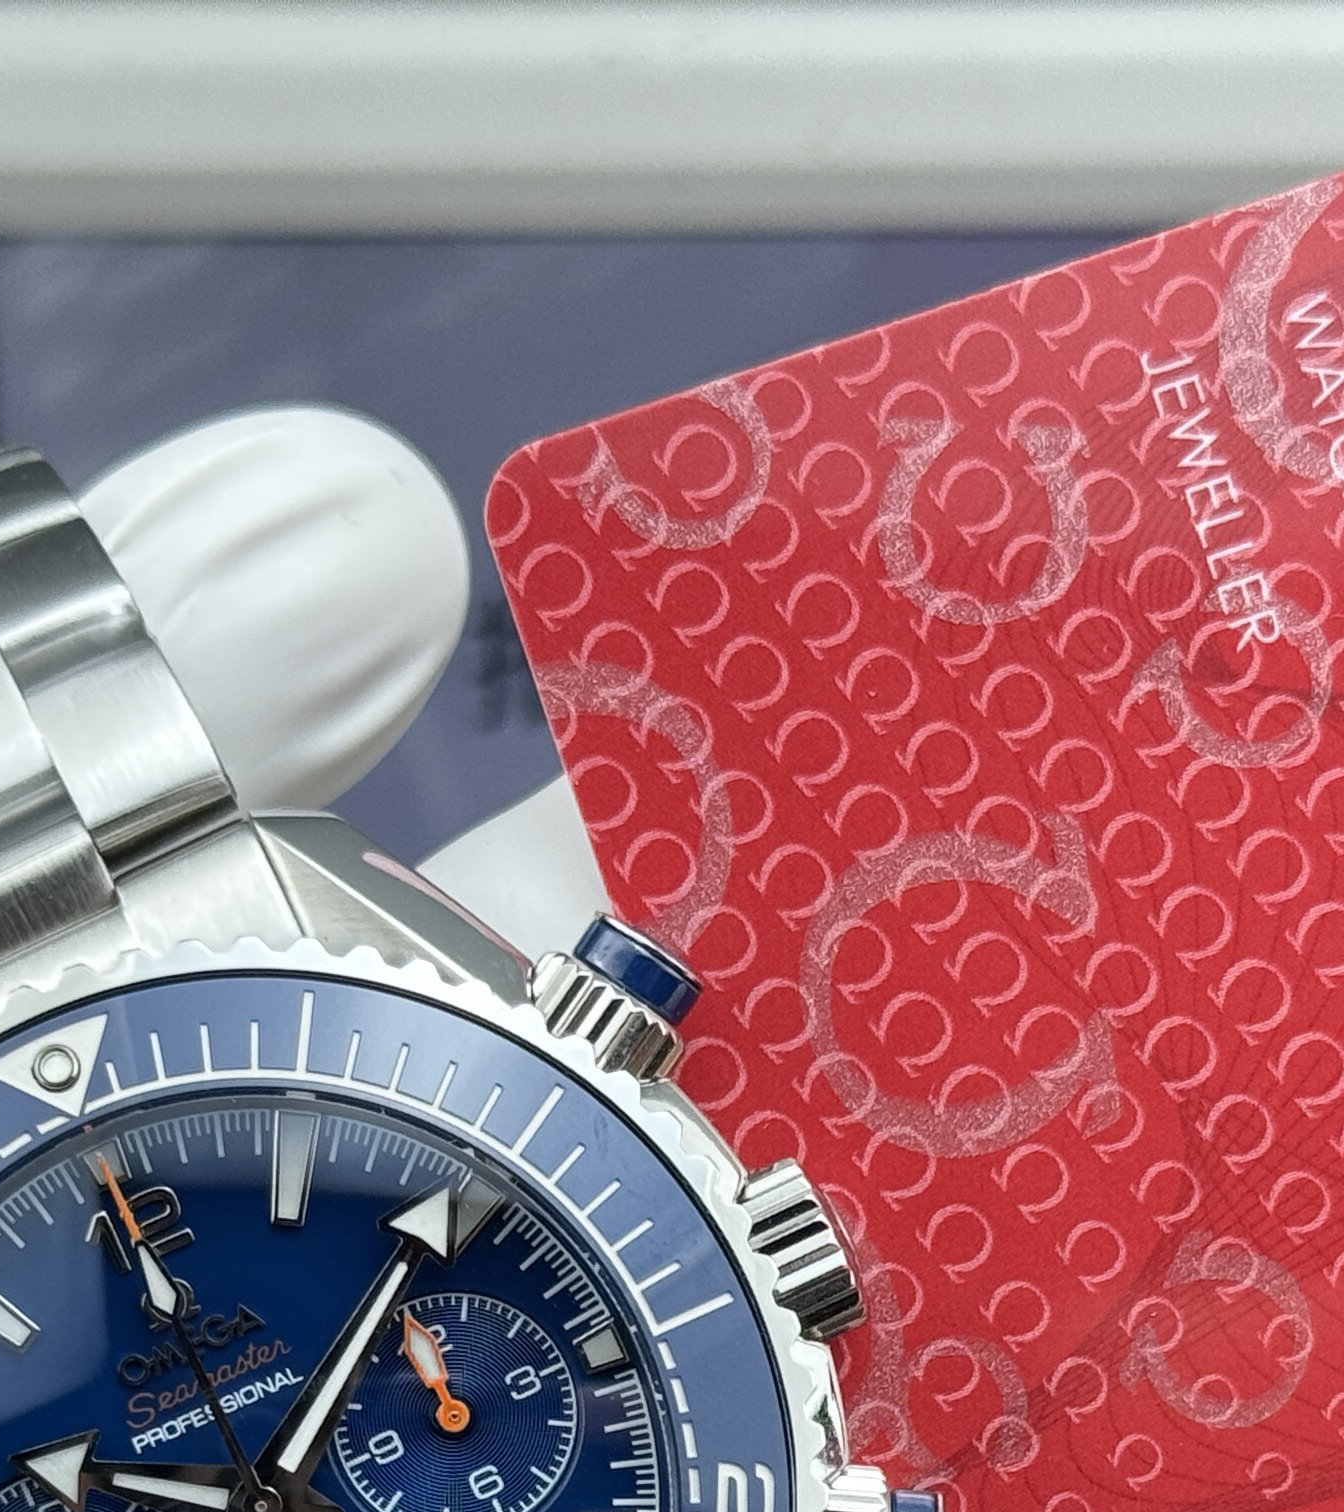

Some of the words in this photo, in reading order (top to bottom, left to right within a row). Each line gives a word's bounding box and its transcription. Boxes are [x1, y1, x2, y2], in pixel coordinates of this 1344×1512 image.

[1140, 350, 1282, 652] JEWELLER
[504, 1364, 542, 1401] 3
[367, 1429, 405, 1466] 9
[468, 1464, 505, 1501] 6
